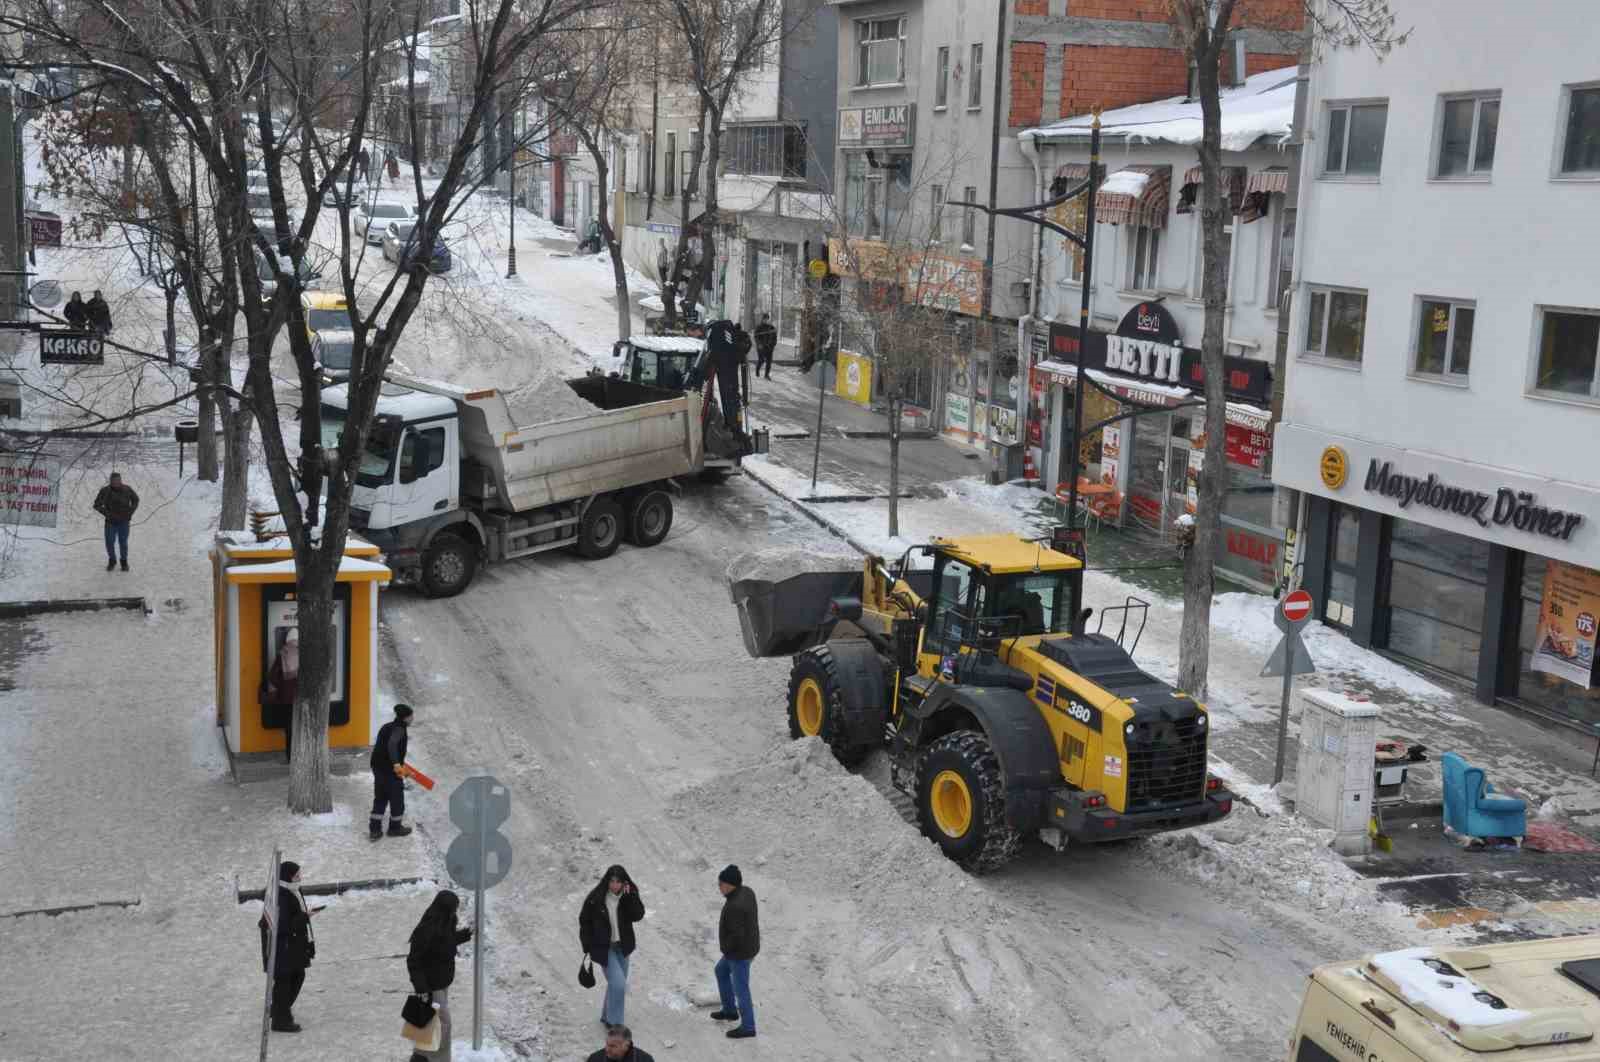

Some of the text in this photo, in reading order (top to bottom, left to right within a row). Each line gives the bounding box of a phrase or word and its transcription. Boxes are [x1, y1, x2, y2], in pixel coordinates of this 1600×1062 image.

[864, 107, 905, 125] EMLAK
[1106, 334, 1182, 382] BEYTİ
[1364, 457, 1583, 541] Maydonoz Döner
